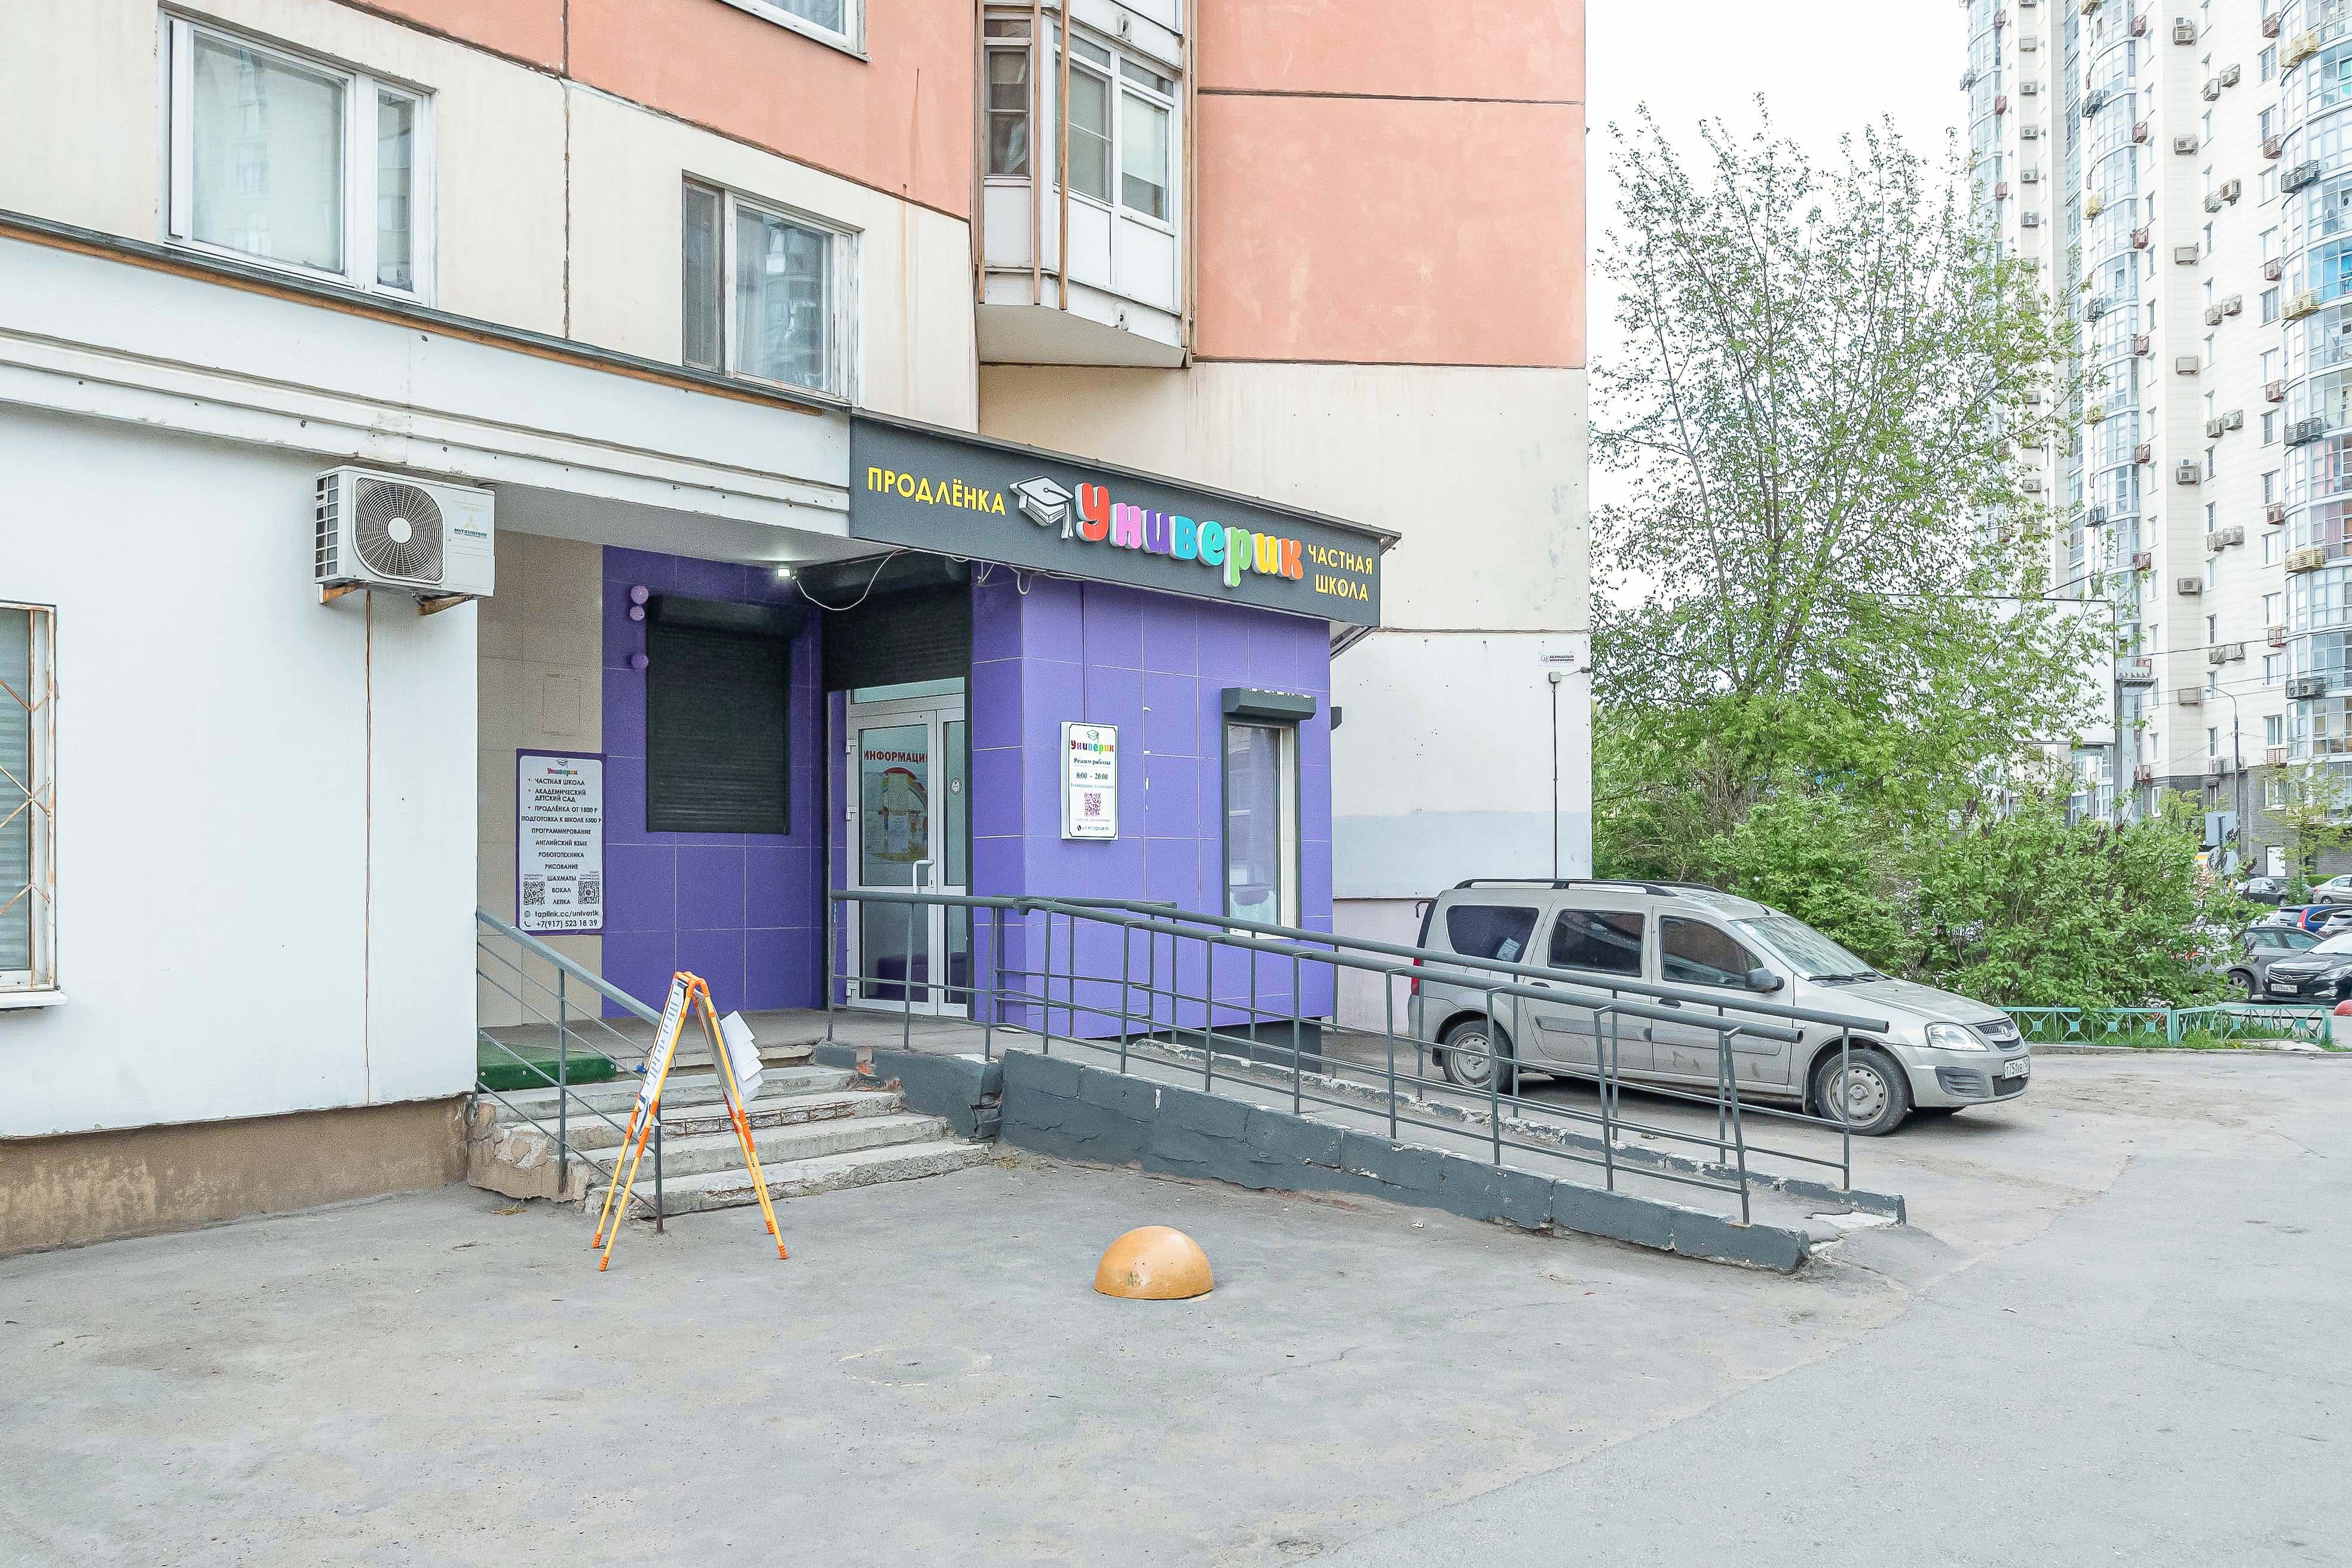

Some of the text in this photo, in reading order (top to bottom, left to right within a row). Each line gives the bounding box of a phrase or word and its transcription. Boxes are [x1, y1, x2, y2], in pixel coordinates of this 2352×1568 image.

[868, 466, 1006, 516] ПРОДЛЁНКА
[1074, 482, 1304, 588] Универик
[1307, 544, 1373, 575] ЧАСТНАЯ
[1315, 574, 1370, 602] ШКОЛА
[863, 750, 928, 764] ИНФОРМАЦИ
[535, 909, 599, 919] taplink.cc/univerik
